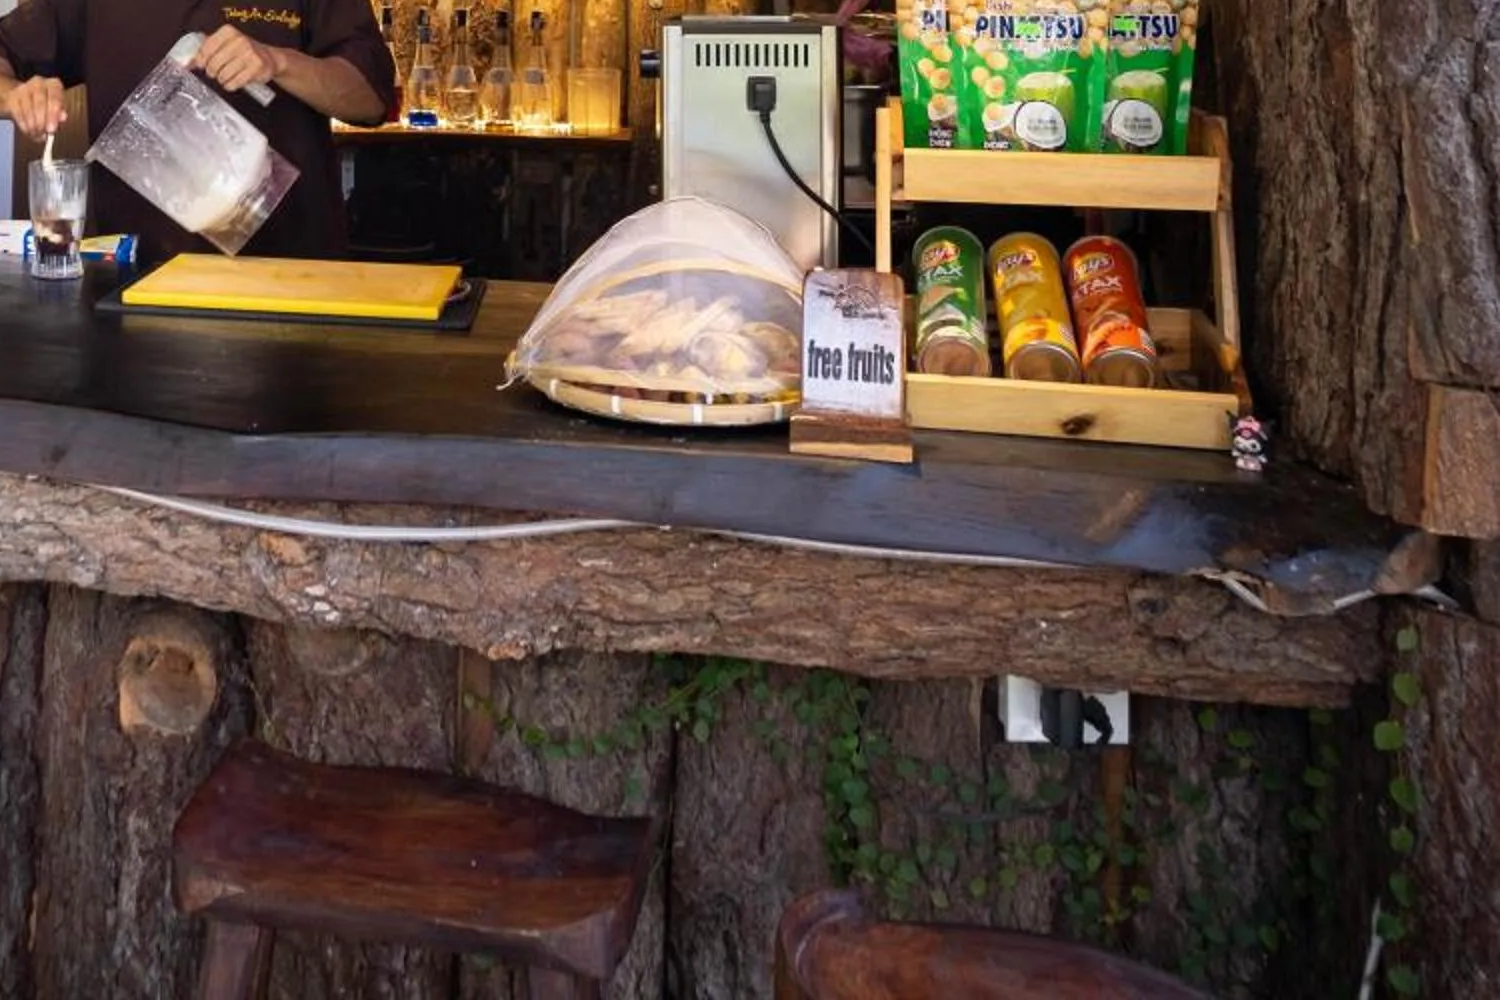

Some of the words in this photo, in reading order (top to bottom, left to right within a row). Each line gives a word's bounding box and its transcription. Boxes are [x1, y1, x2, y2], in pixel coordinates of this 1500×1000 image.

[975, 15, 1084, 40] PINTSU
[807, 339, 842, 380] free
[847, 341, 895, 385] fruits
